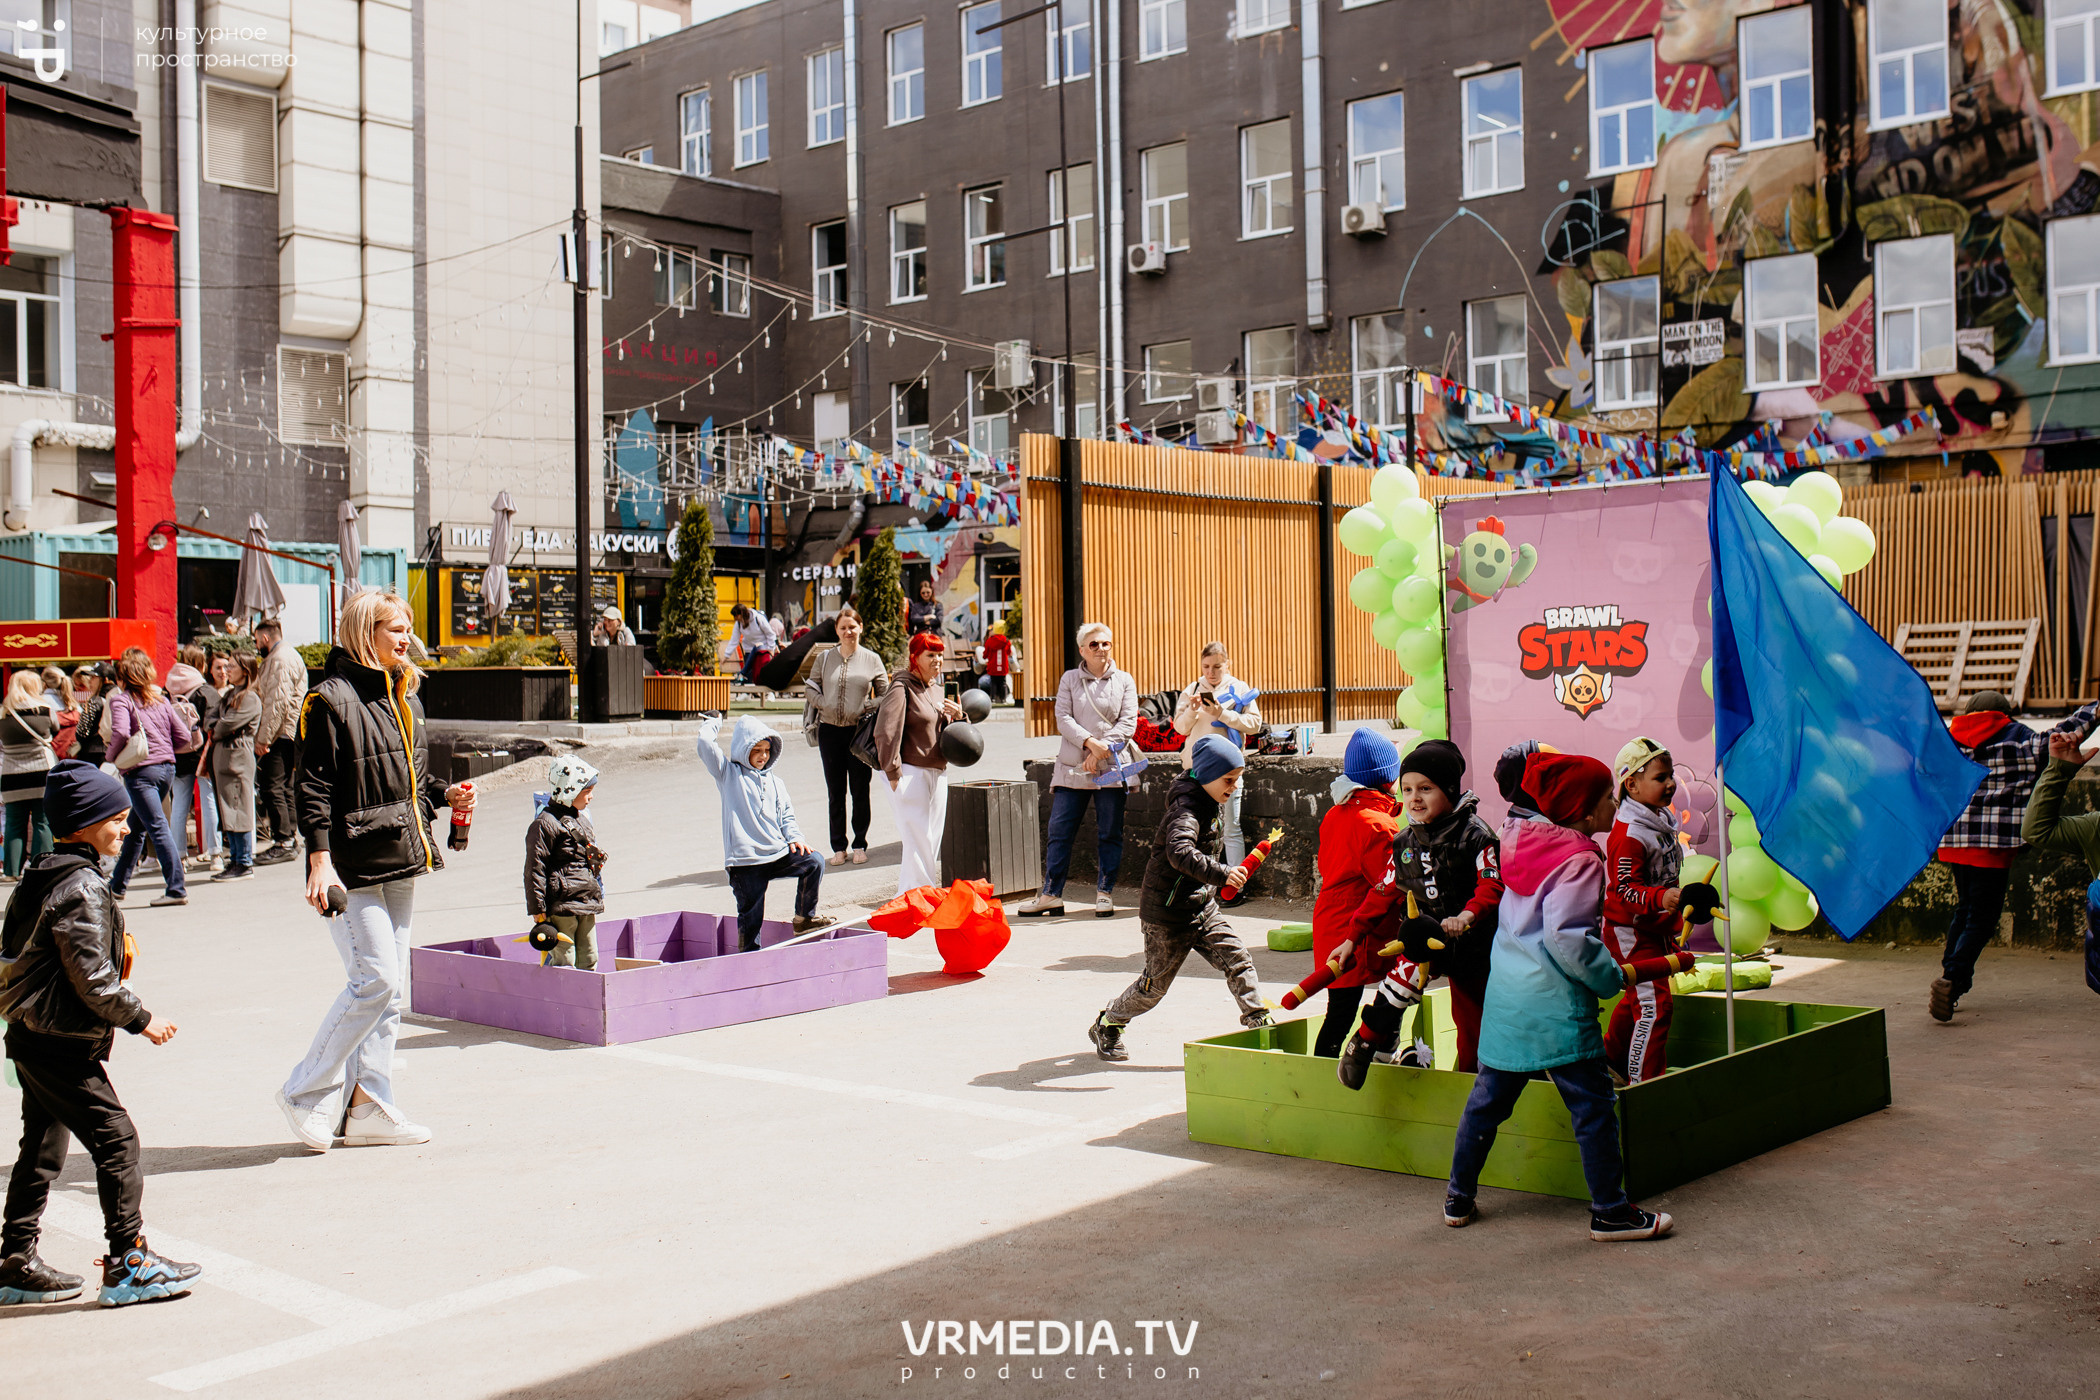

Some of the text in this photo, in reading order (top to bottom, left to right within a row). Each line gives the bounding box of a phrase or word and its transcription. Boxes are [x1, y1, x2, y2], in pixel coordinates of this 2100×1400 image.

[1664, 320, 1721, 338] MAN ON THE
[1694, 335, 1723, 347] MOON
[450, 527, 659, 554] ПИВ ЕДА АКУСКИ
[792, 563, 862, 581] СЕРВАН
[820, 585, 842, 597] БАР
[1544, 604, 1623, 630] BRAWL
[1518, 621, 1649, 674] STARS
[1642, 1004, 1654, 1019] AM
[1629, 1020, 1651, 1083] UNSTOPPABLE
